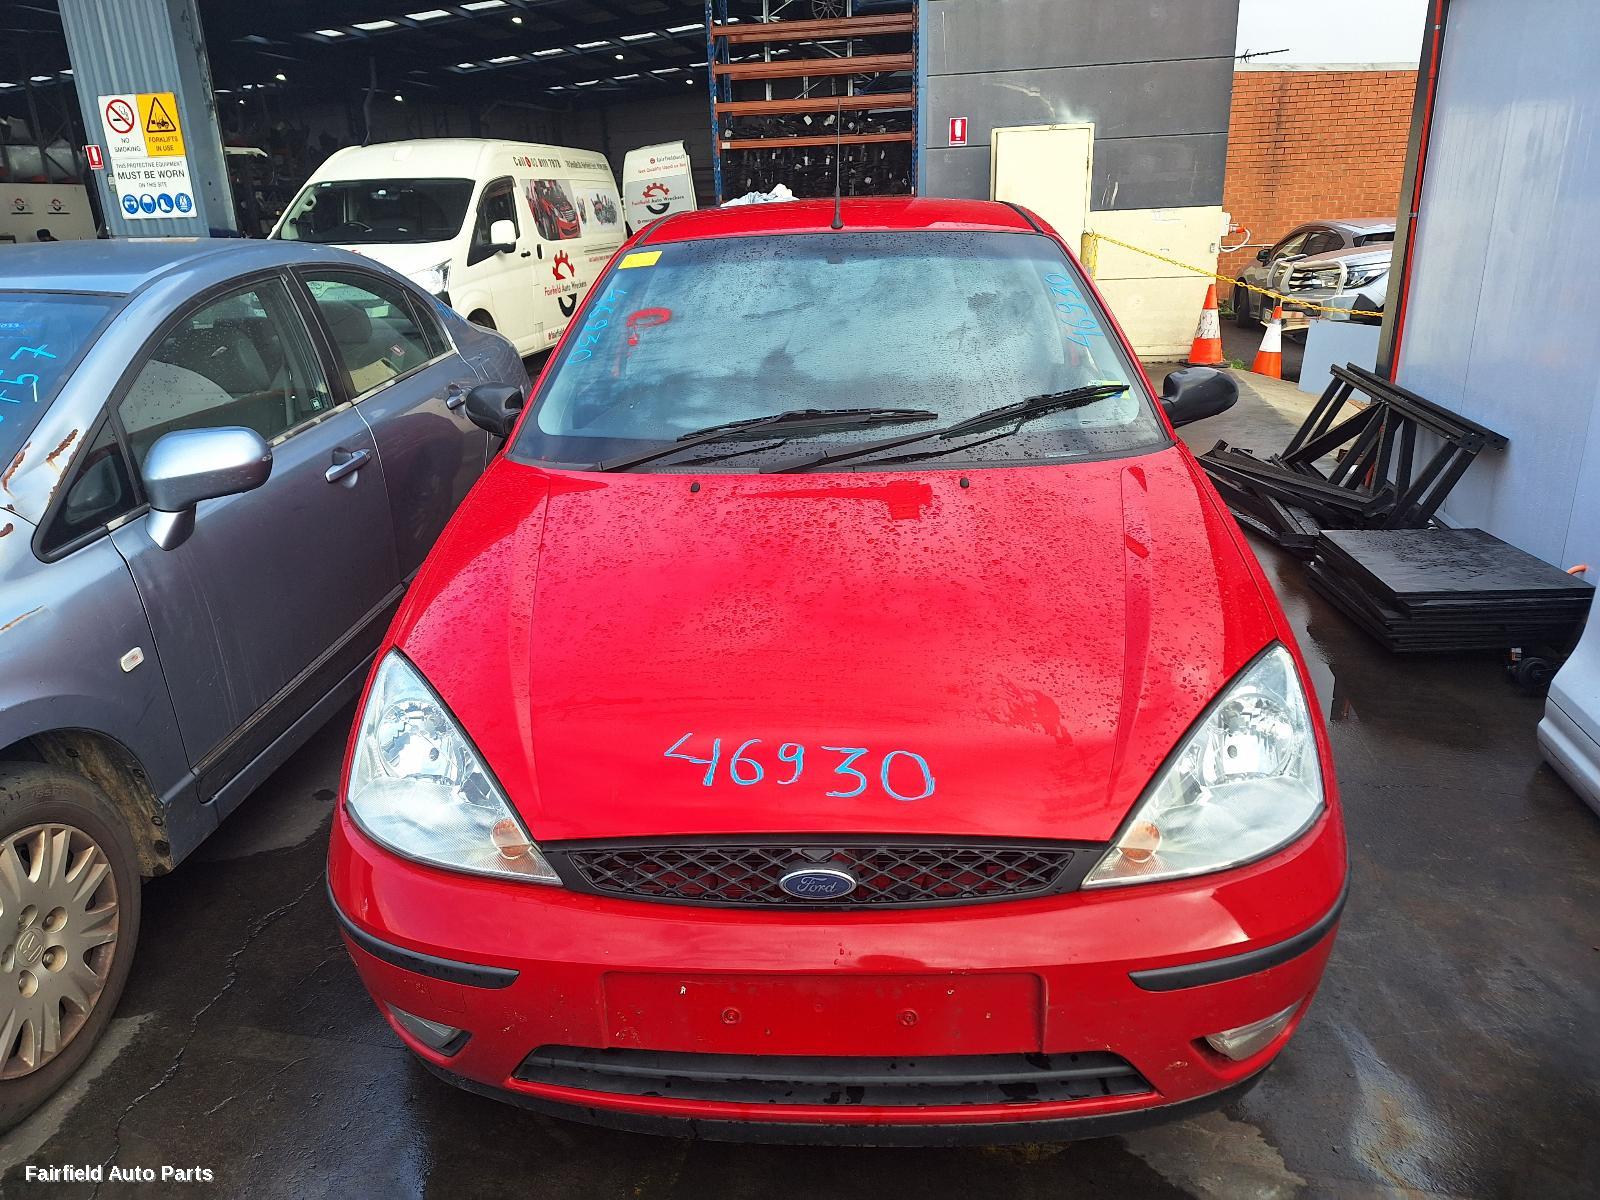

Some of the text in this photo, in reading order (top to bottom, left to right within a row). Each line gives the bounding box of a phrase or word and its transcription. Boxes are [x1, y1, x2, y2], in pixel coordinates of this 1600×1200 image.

[117, 169, 185, 180] MUST BE WORN
[544, 283, 561, 297] Fairfield
[1045, 274, 1103, 346] 46930
[663, 732, 936, 801] 46930
[796, 876, 837, 894] Ford
